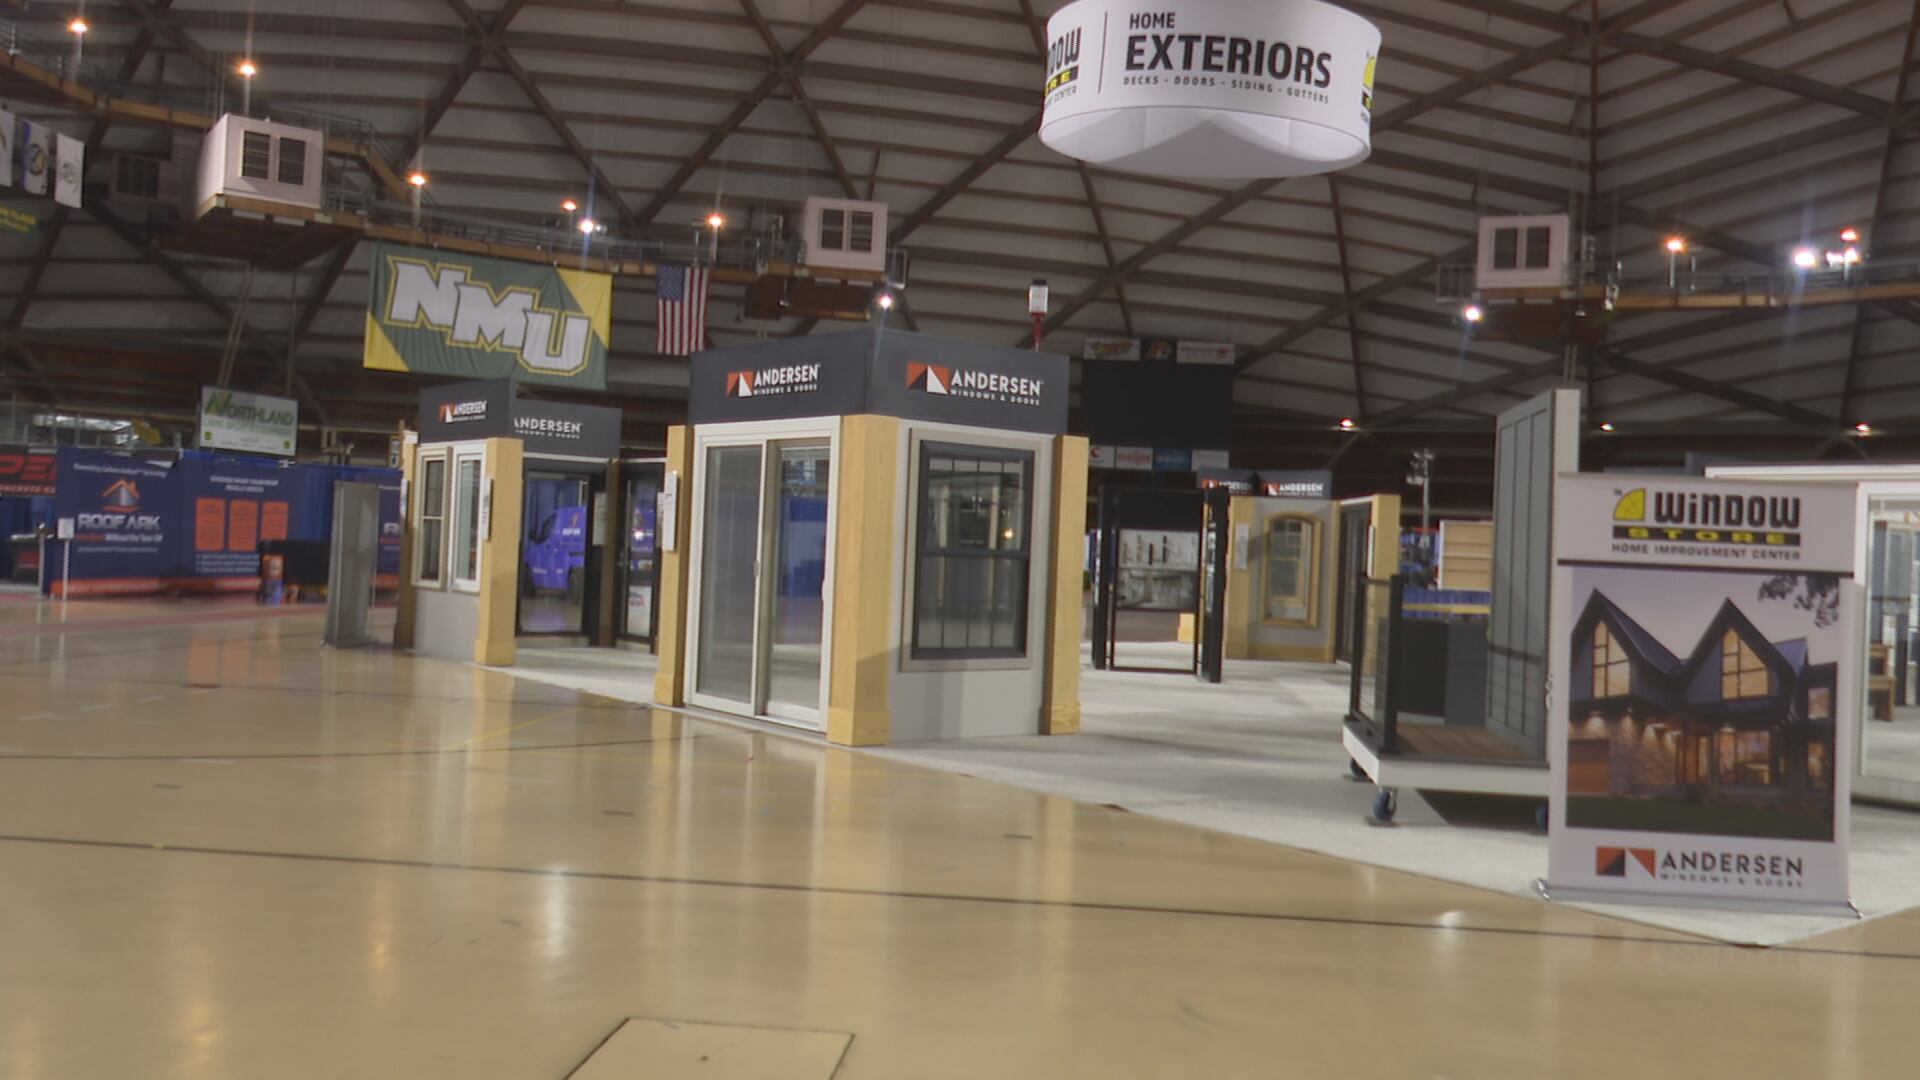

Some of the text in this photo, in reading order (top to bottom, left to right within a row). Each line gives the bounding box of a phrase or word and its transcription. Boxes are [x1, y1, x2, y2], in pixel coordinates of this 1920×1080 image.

[1129, 12, 1176, 30] HOME
[1125, 34, 1332, 88] EXTERIORS
[1123, 76, 1329, 104] DECKS DOORS SIDING GUTTERS
[384, 256, 592, 376] NMU
[753, 365, 819, 387] ANDERSEN
[951, 369, 1041, 396] ANDERSEN
[205, 390, 294, 426] NORTHLAND
[1279, 482, 1323, 491] ANDERSEN
[78, 514, 160, 531] ROOF ARK
[1628, 528, 1785, 545] STORE
[1612, 543, 1800, 561] HOME IMPROVEMENT CENTER
[1661, 851, 1803, 876] ANDERSEN
